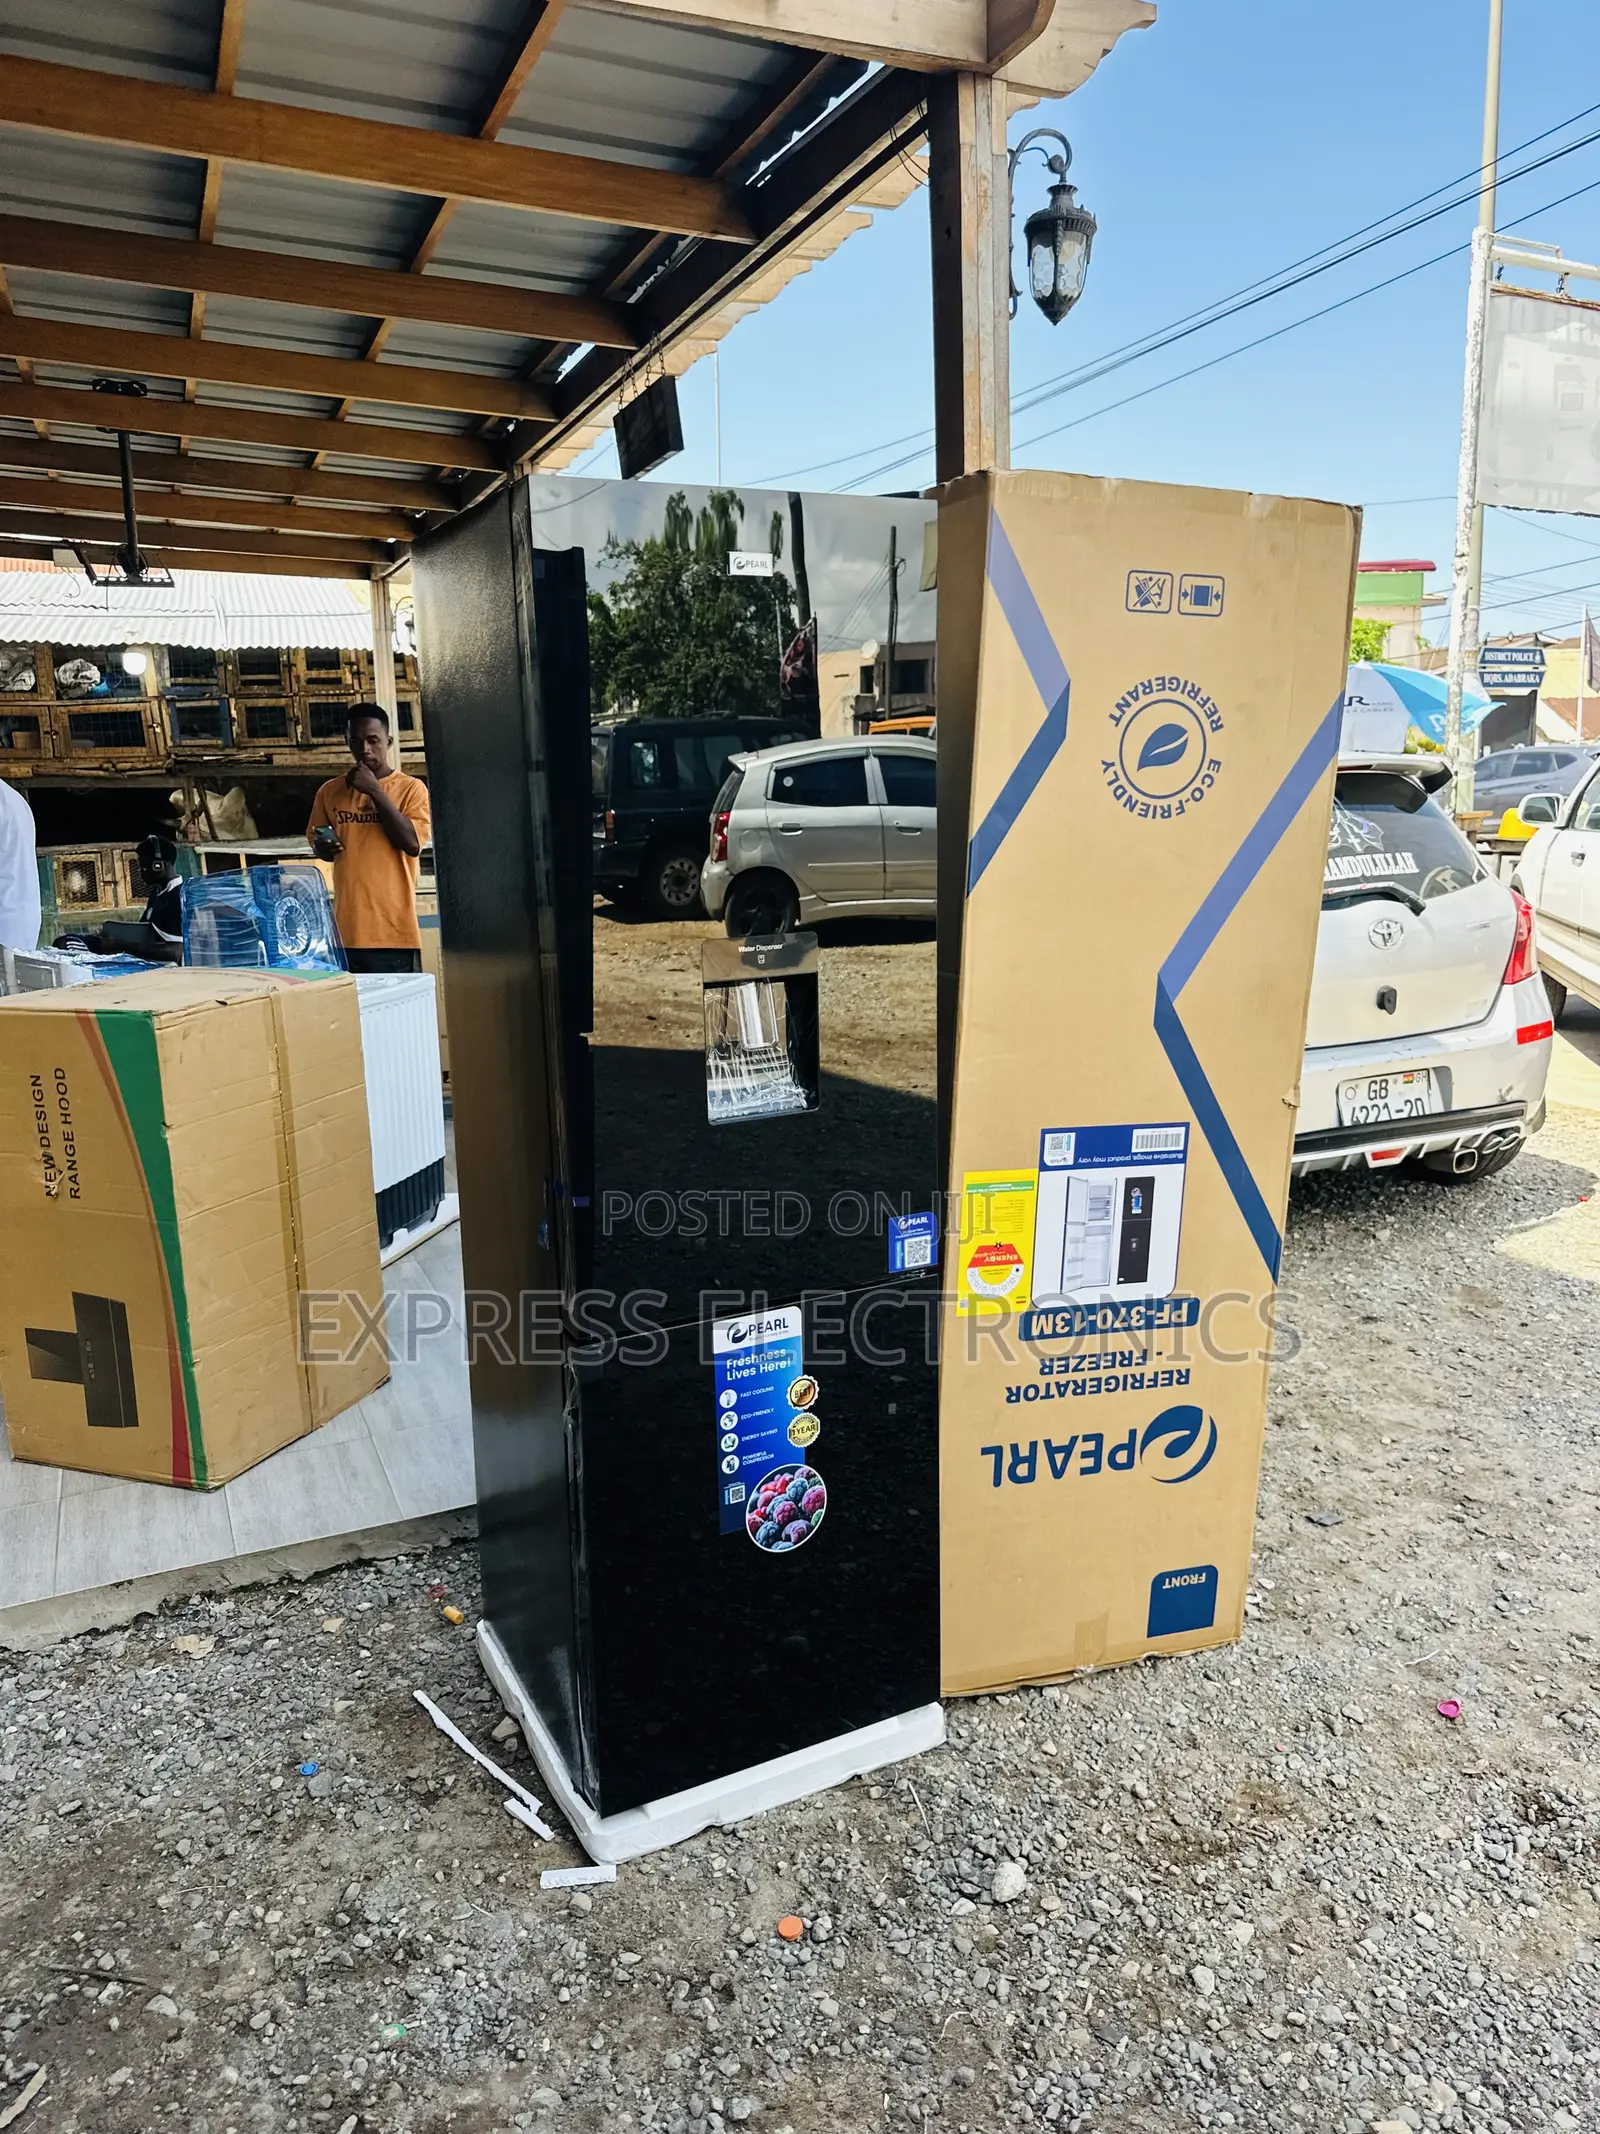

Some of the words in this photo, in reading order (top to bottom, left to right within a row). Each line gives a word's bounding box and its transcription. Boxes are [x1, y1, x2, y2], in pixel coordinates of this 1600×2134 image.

[745, 560, 768, 569] PEARL
[1485, 652, 1511, 661] DISTRICT
[1512, 652, 1534, 661] POLICE
[1504, 673, 1540, 684] ADABRAKA
[1108, 676, 1224, 733] REFRIGERANT
[1101, 758, 1222, 819] ECO-FRIENDLY
[1324, 852, 1420, 881] AMDULILLAH
[738, 945, 755, 953] Water
[756, 943, 783, 952] Dispenser
[54, 1068, 72, 1124] HOOD
[1368, 1079, 1389, 1101] GB
[30, 1075, 51, 1148] DESIGN
[41, 1152, 57, 1198] NEW
[63, 1130, 81, 1199] RANGE
[908, 1216, 929, 1226] PEARL
[748, 1317, 789, 1336] PEARL
[1031, 1302, 1188, 1337] PF-370-13M
[726, 1348, 786, 1369] Freshness
[727, 1366, 757, 1381] Lives
[759, 1357, 791, 1374] Here!
[1039, 1348, 1148, 1376] FREEZER
[752, 1386, 774, 1396] COOLING
[794, 1386, 811, 1399] BEST
[1005, 1368, 1191, 1404] REFRIGERATOR
[742, 1432, 760, 1442] ENERGY
[796, 1424, 816, 1435] YEAR
[980, 1428, 1137, 1489] PEARL
[1162, 1572, 1206, 1589] FRONT
